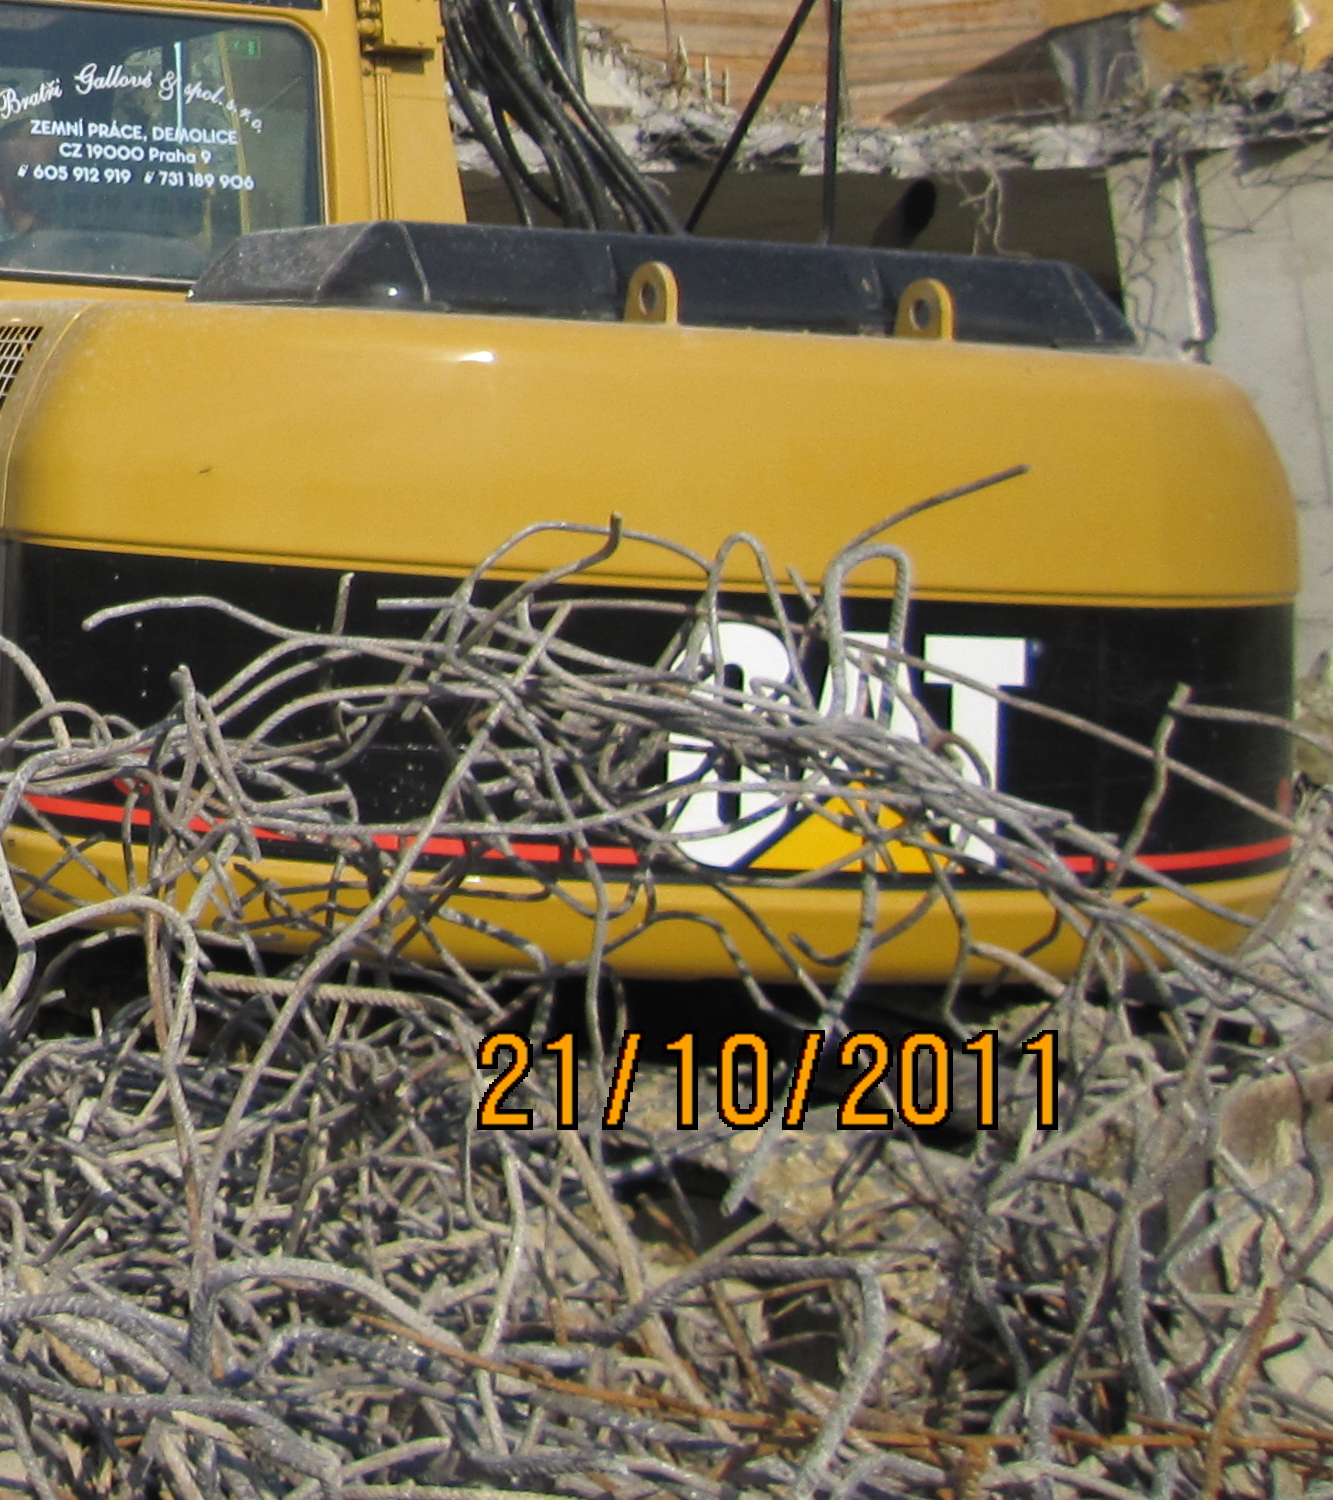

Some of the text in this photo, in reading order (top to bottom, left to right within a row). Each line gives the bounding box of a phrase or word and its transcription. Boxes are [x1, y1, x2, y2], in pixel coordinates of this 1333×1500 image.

[158, 70, 181, 100] &
[30, 118, 238, 145] ZEMNÍ PRÁCE, DEMOLICE
[58, 142, 212, 165] CZ 19000 Praha 9
[33, 164, 255, 191] 605 912 919 731 189 906
